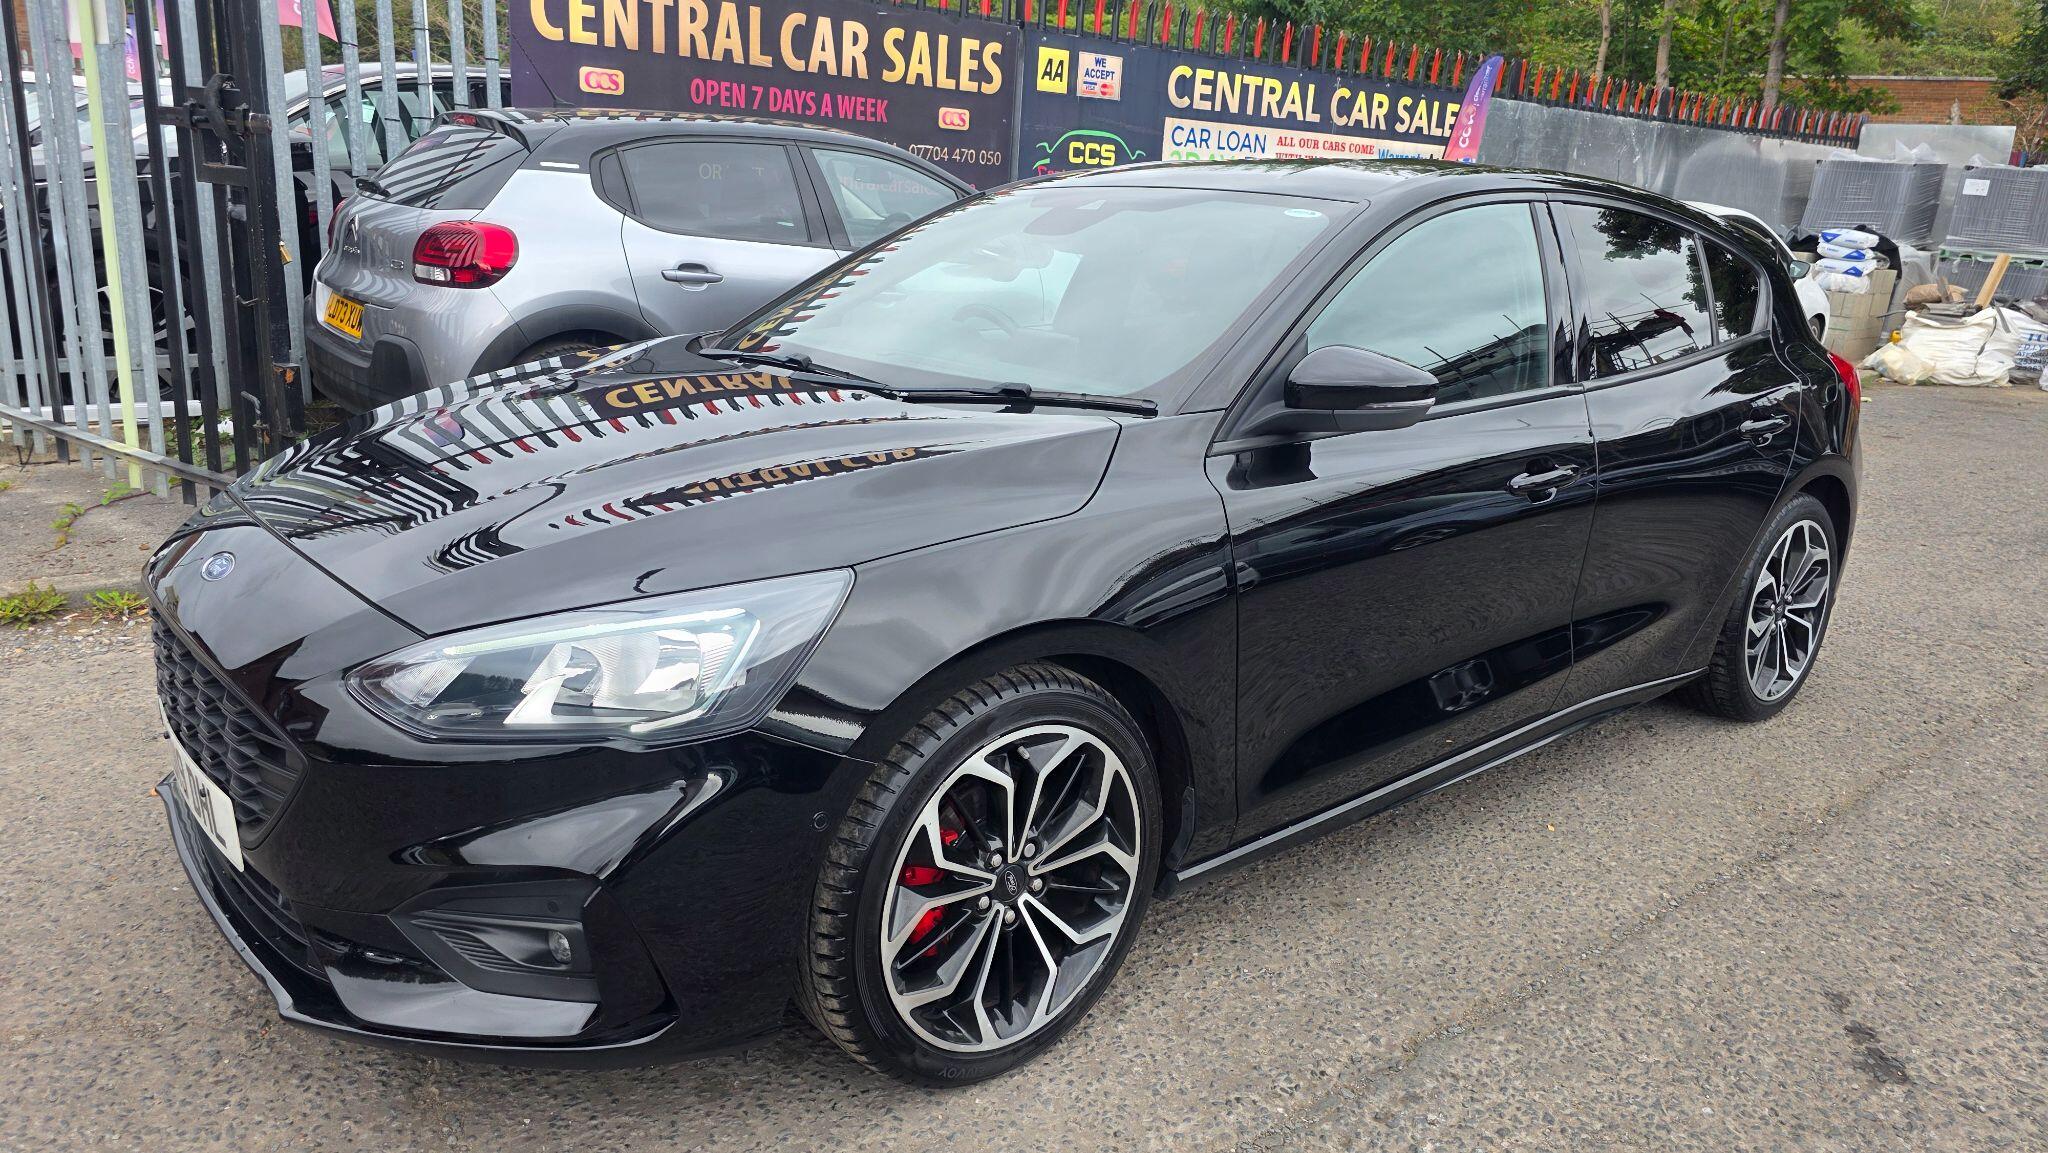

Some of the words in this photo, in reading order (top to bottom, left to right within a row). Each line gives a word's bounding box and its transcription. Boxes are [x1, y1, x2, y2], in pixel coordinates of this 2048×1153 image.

[530, 0, 773, 67] CENTRAL
[780, 12, 869, 80] CAR
[881, 27, 1003, 95] SALES
[1041, 58, 1065, 82] AA
[1084, 67, 1116, 81] ACCEPT
[1094, 56, 1107, 68] WE
[690, 78, 746, 109] OPEN
[751, 86, 764, 110] 7
[768, 87, 816, 116] DAYS
[820, 93, 833, 118] A
[837, 94, 888, 123] WEEK
[1167, 65, 1321, 122] CENTRAL
[1330, 87, 1389, 131] CAR
[1171, 125, 1211, 149] CAR
[1217, 130, 1267, 154] LOAN
[1276, 136, 1296, 147] ALL
[1299, 138, 1320, 150] OUR
[1323, 141, 1347, 152] CARS
[1349, 143, 1375, 155] COME
[908, 144, 948, 162] 07704
[952, 148, 976, 164] 470
[979, 150, 1002, 166] 050
[1068, 141, 1116, 166] CCS
